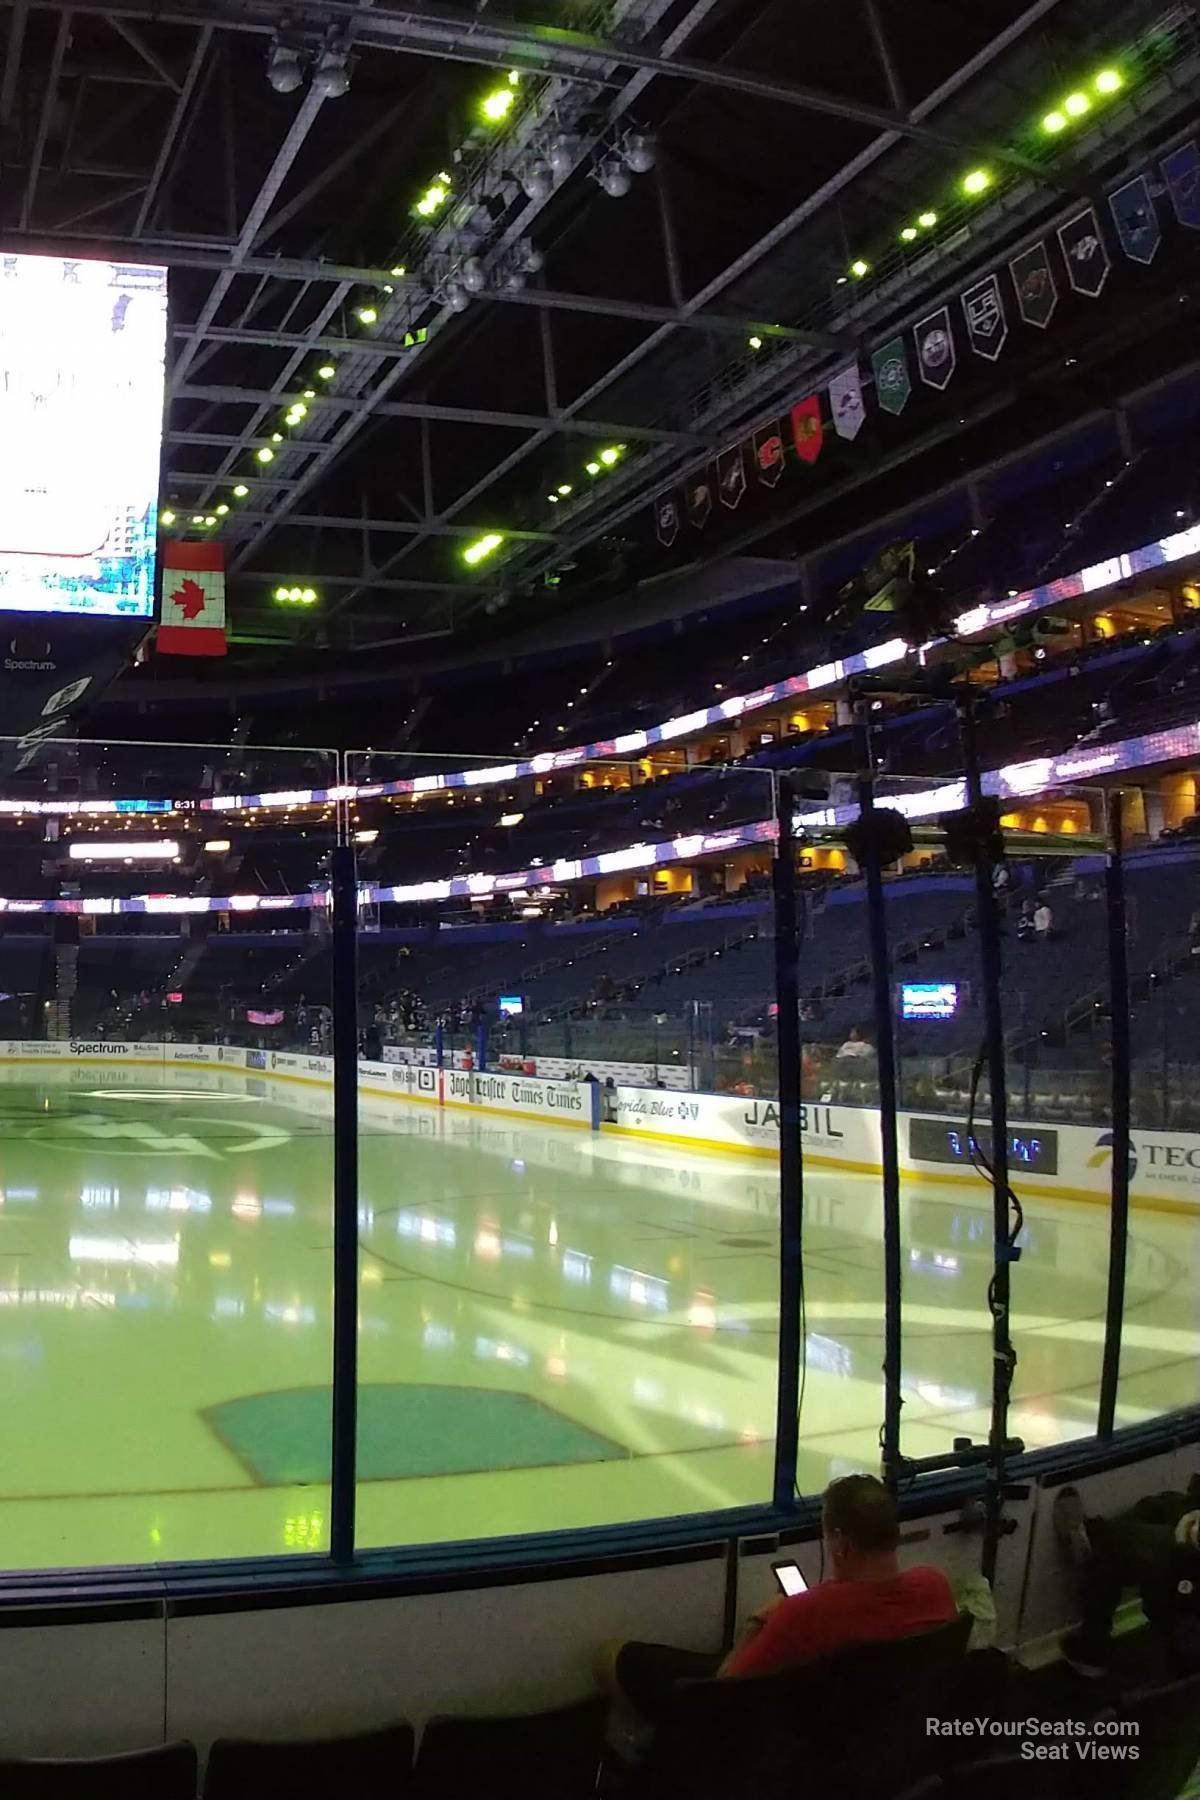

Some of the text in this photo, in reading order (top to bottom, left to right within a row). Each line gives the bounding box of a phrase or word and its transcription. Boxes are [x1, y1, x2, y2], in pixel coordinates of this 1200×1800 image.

[4, 658, 54, 672] Spectrum
[174, 800, 195, 809] 6:31
[70, 1042, 126, 1055] Spectrum
[512, 1081, 544, 1105] Times
[547, 1085, 582, 1110] Times
[617, 1098, 674, 1118] orida Blue
[1142, 1145, 1200, 1169] TEC
